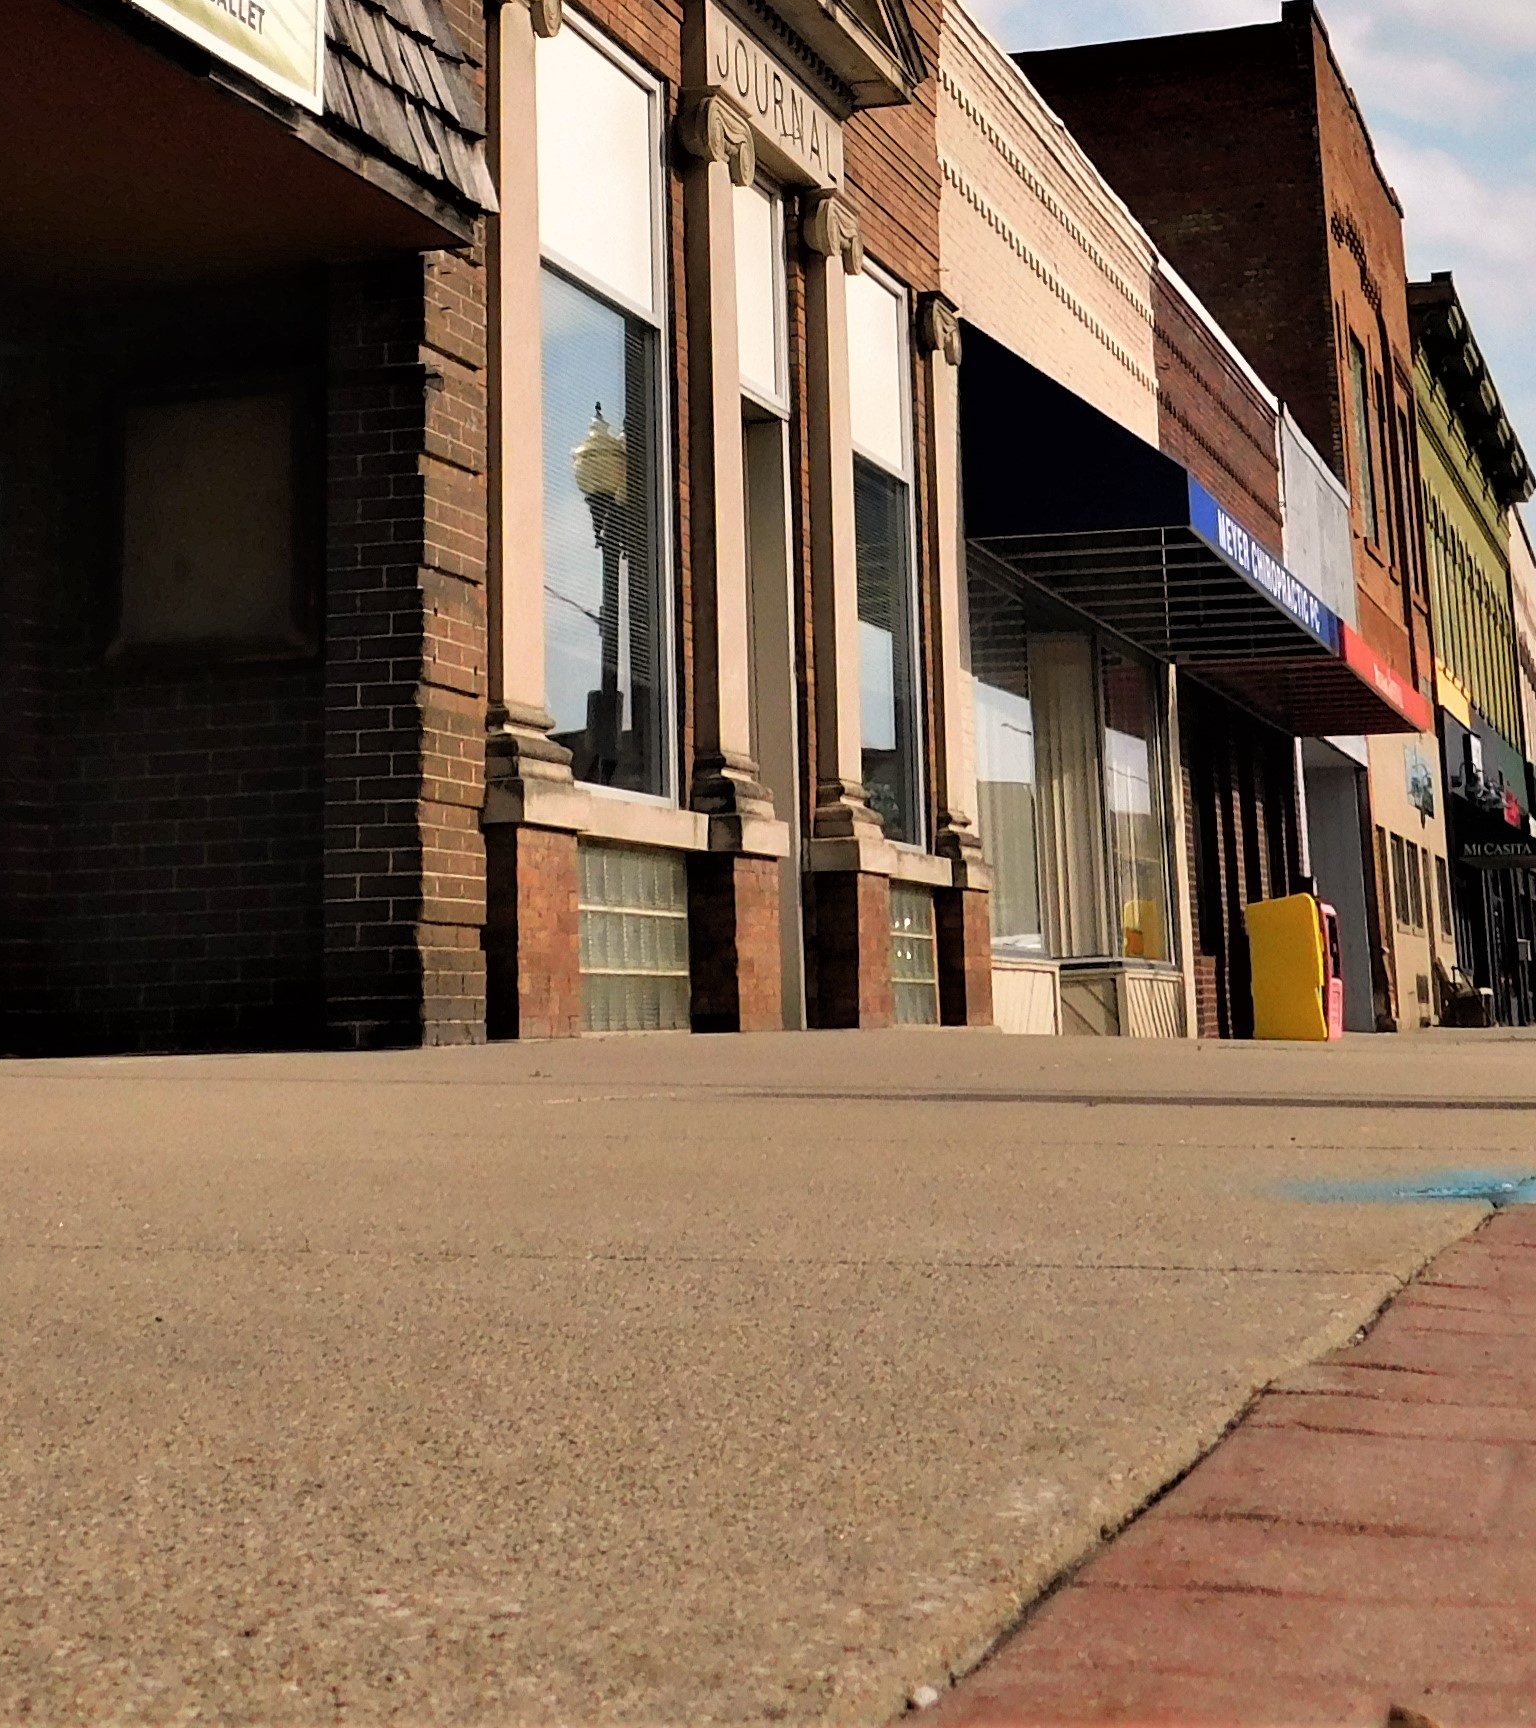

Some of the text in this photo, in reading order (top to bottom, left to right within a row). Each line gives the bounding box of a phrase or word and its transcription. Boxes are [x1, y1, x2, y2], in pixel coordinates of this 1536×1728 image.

[716, 24, 837, 186] JOURNAL
[1217, 508, 1320, 634] MEYER CHIROPRACTIC PC
[1484, 843, 1532, 855] CASITA
